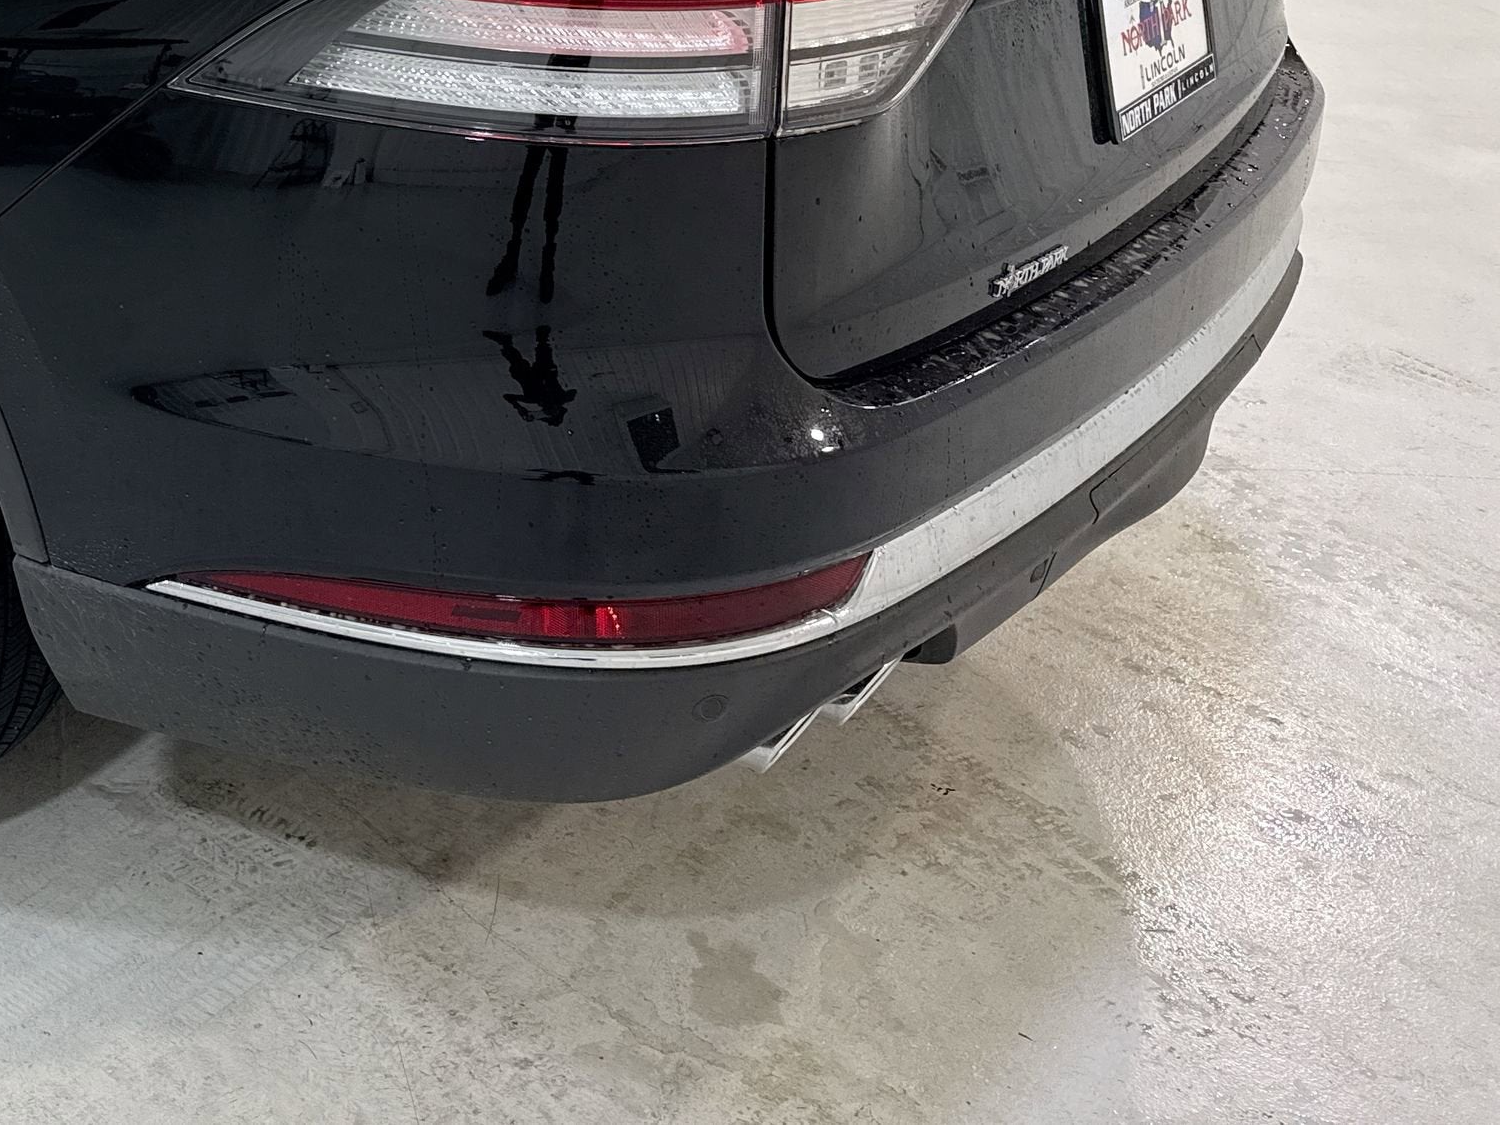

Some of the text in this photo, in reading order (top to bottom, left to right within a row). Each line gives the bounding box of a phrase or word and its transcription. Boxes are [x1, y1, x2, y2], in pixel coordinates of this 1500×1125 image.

[1121, 9, 1161, 57] NORTH
[1145, 43, 1186, 82] LINCOLN
[1121, 98, 1153, 136] NORTH
[1152, 82, 1177, 116] PARK
[1181, 63, 1214, 92] LINCOLN
